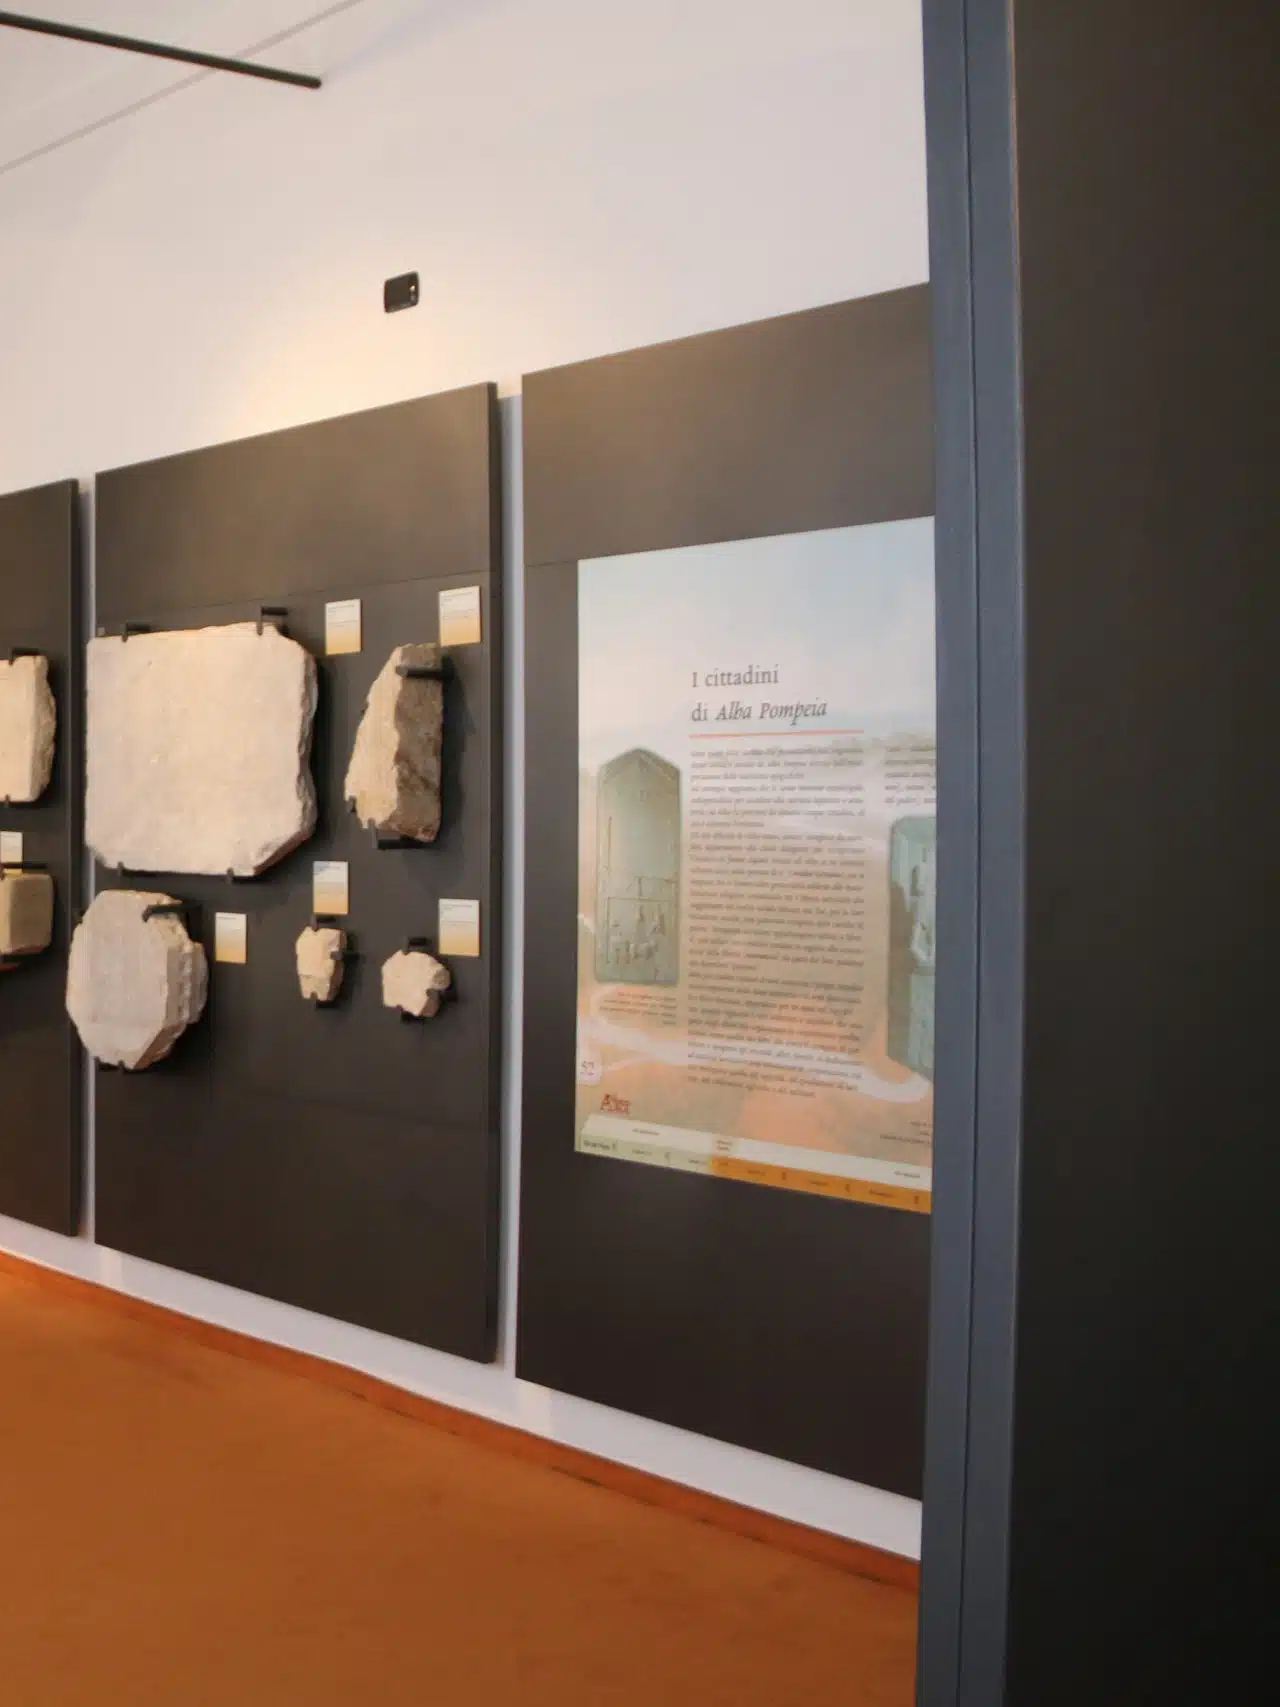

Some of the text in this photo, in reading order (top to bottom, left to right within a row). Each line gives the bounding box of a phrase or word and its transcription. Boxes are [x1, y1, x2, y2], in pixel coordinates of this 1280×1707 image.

[691, 663, 780, 688] I cittadini
[691, 696, 829, 727] di Alba Pompeia
